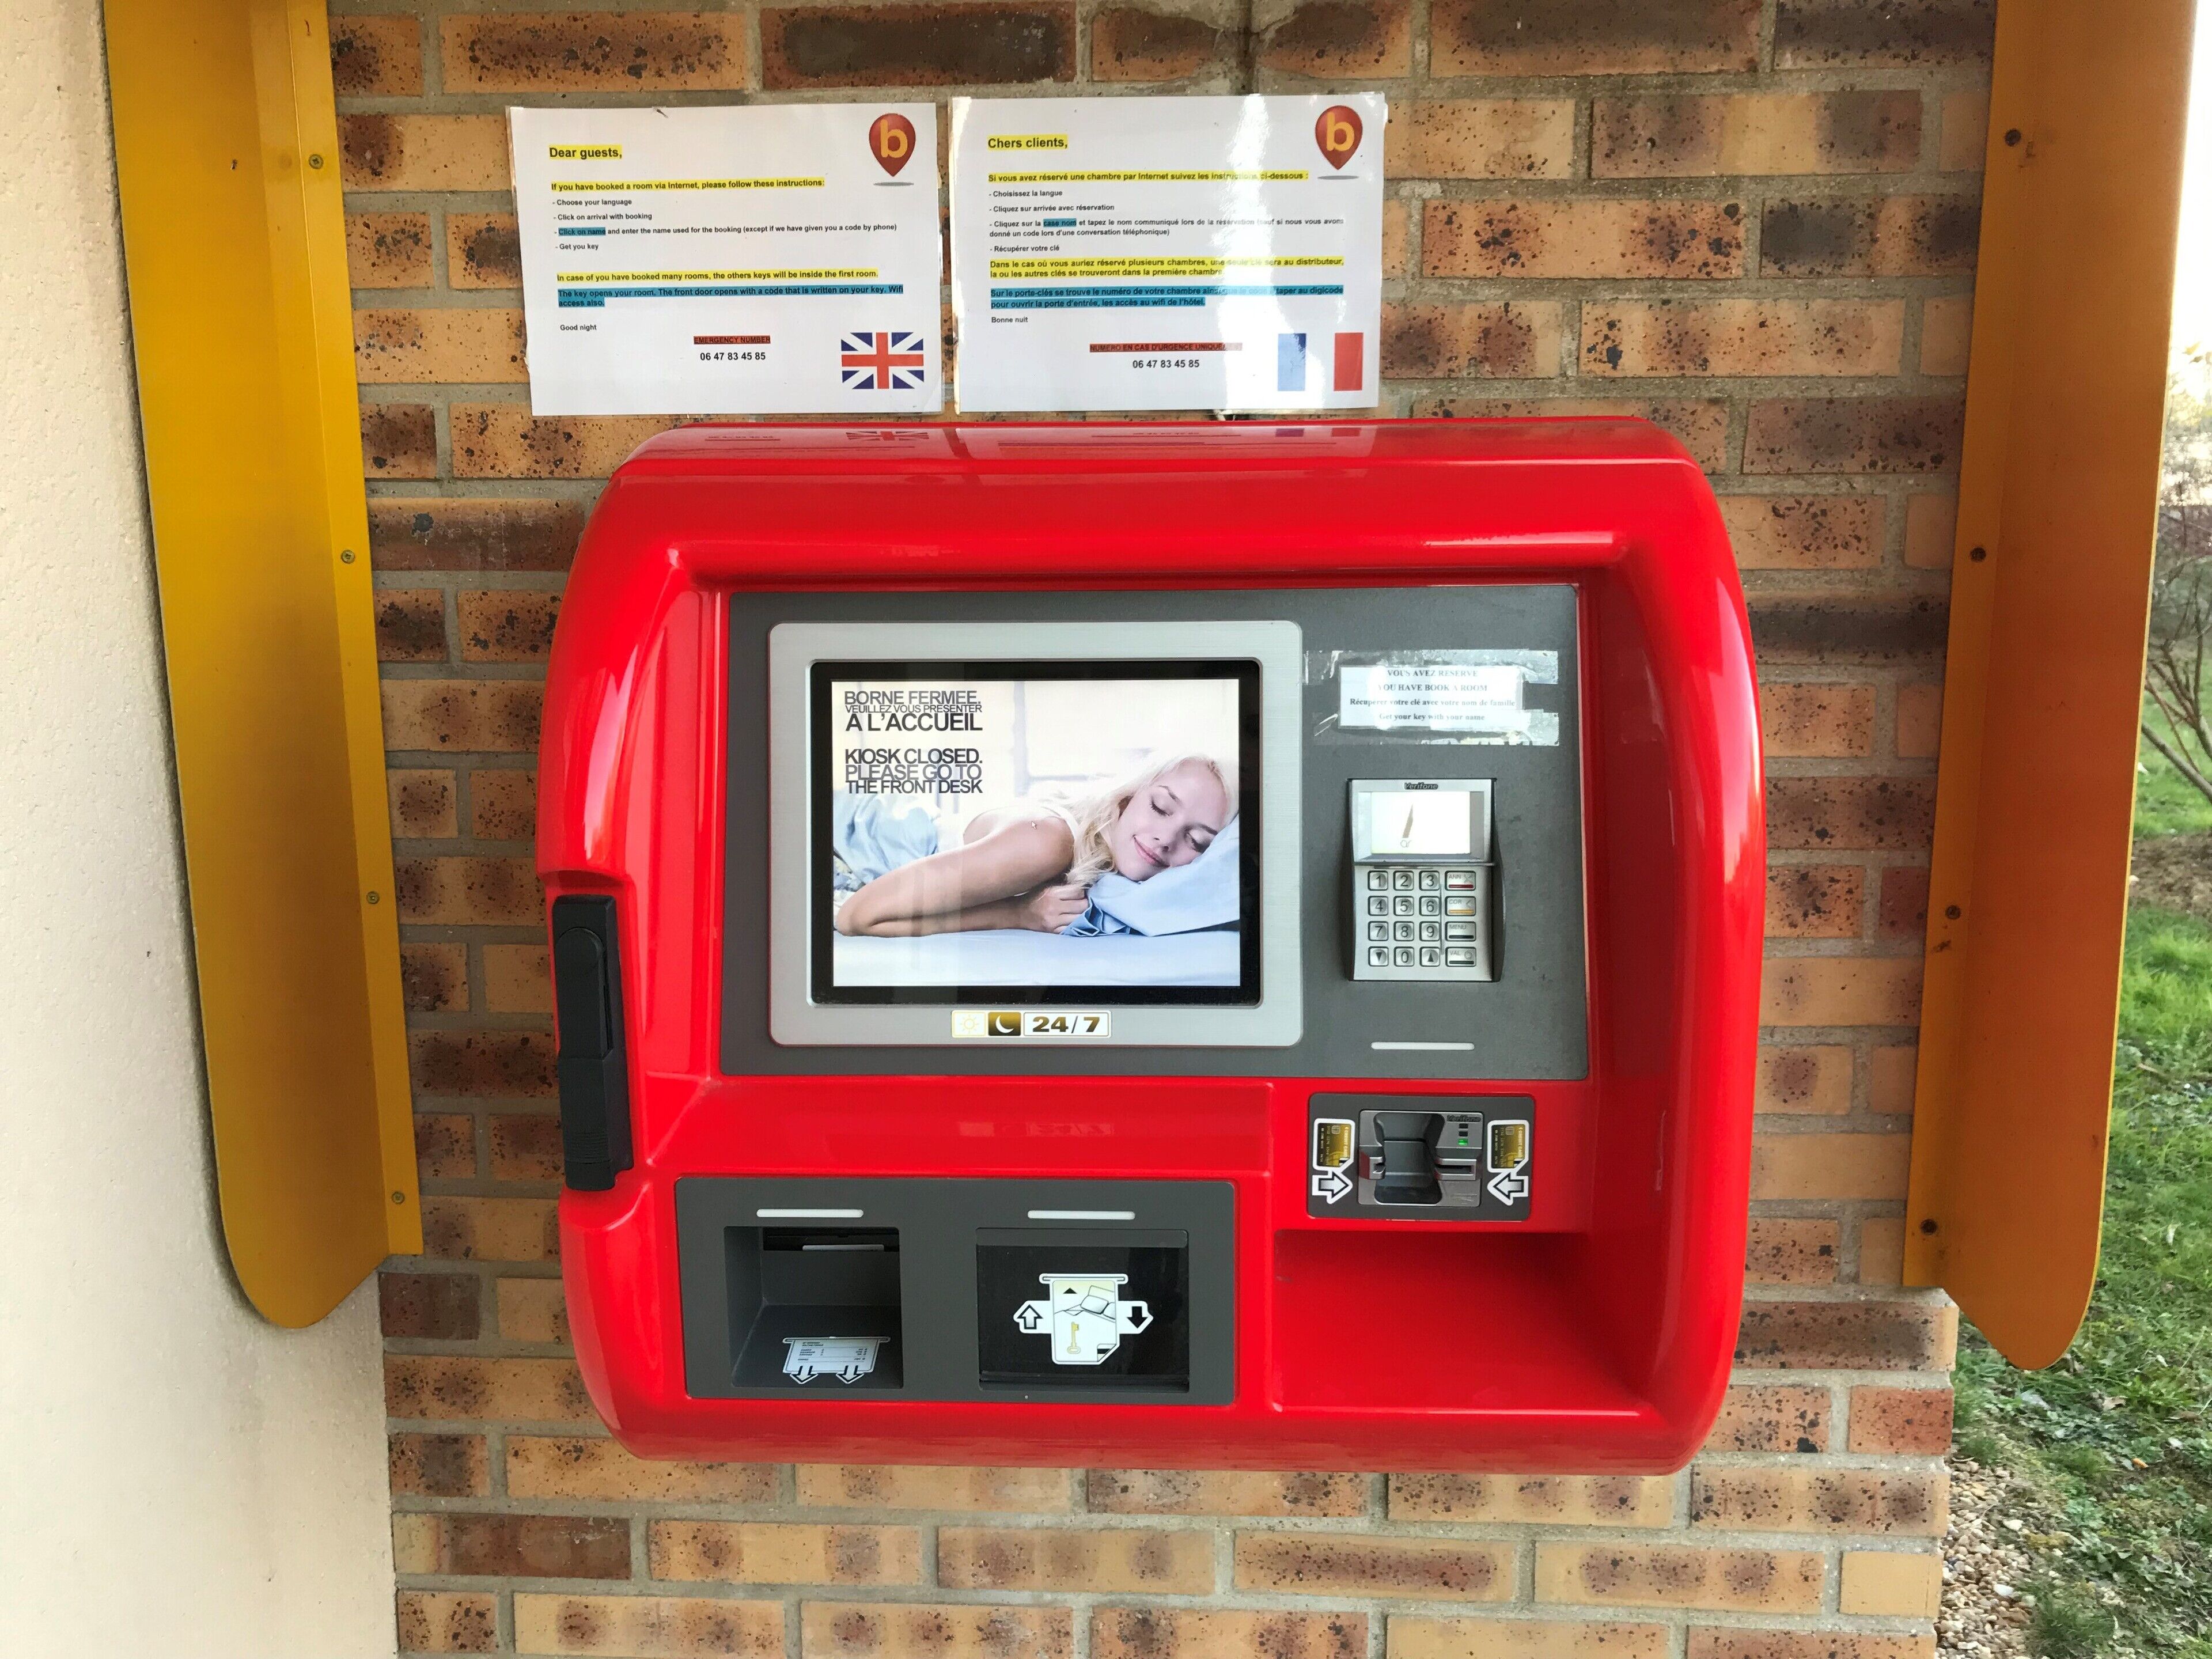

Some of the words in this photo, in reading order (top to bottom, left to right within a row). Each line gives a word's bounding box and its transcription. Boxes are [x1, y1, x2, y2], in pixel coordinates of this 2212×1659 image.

[1326, 112, 1354, 151] b
[880, 119, 908, 158] b
[988, 138, 1022, 148] Chers
[1026, 137, 1067, 149] clients,
[550, 147, 577, 157] Dear
[579, 147, 622, 160] guests,
[1123, 228, 1169, 236] téléphonique)
[753, 271, 771, 279] keys
[1152, 268, 1186, 276] première
[714, 352, 724, 360] 47
[728, 352, 738, 360] 83
[741, 352, 752, 360] 45
[1132, 360, 1143, 368] 06
[1174, 359, 1185, 368] 45
[845, 691, 904, 704] BORNE
[909, 691, 981, 704] FERMEE.
[846, 704, 892, 713] VEUILLEZ
[893, 704, 921, 713] VOUS
[923, 704, 982, 713] PRESENTER
[846, 713, 863, 731] A
[868, 713, 983, 731] L'ACCUEIL
[1414, 713, 1426, 721] key
[845, 748, 902, 764] KIOSK
[904, 748, 983, 764] CLOSED.
[846, 764, 919, 780] PLEASE
[922, 764, 952, 780] GO
[955, 764, 982, 780] TO
[846, 780, 877, 794] THE
[881, 779, 936, 794] FRONT
[938, 779, 983, 793] DESK
[1376, 874, 1382, 887] 1
[1400, 874, 1408, 887] 2
[1426, 874, 1434, 887] 3
[1374, 900, 1383, 912] 4
[1400, 900, 1409, 912] 5
[1426, 900, 1434, 912] 6
[1374, 925, 1383, 937] 7
[1401, 925, 1409, 937] 8
[1426, 925, 1434, 937] 9
[1400, 950, 1409, 963] 0
[1032, 1016, 1100, 1033] 24/7
